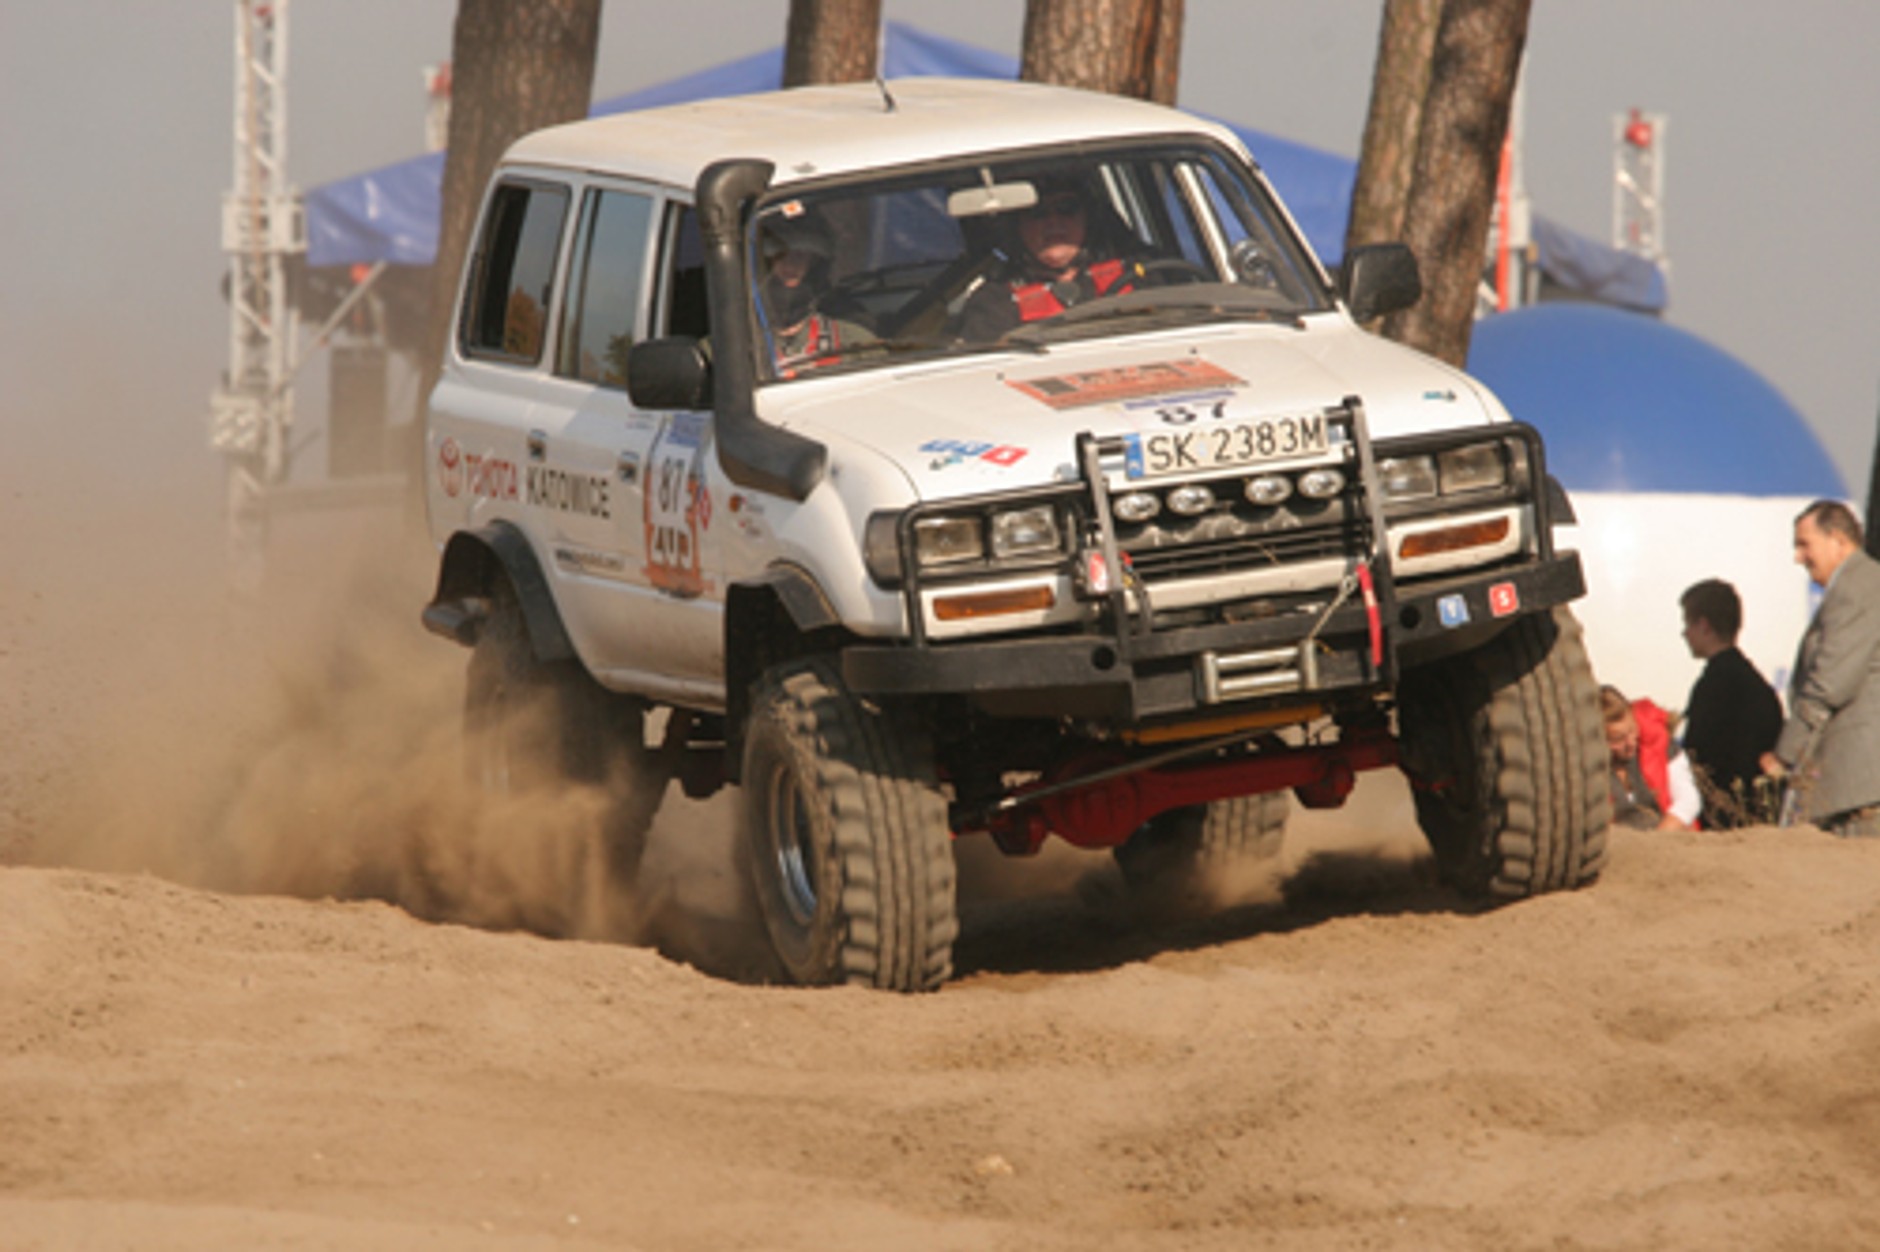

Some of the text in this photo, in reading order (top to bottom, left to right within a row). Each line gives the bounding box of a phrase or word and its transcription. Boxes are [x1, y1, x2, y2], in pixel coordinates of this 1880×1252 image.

[1147, 415, 1325, 471] SK 2383M
[465, 453, 610, 519] TOYOTA KATOWICE
[659, 456, 686, 514] 87
